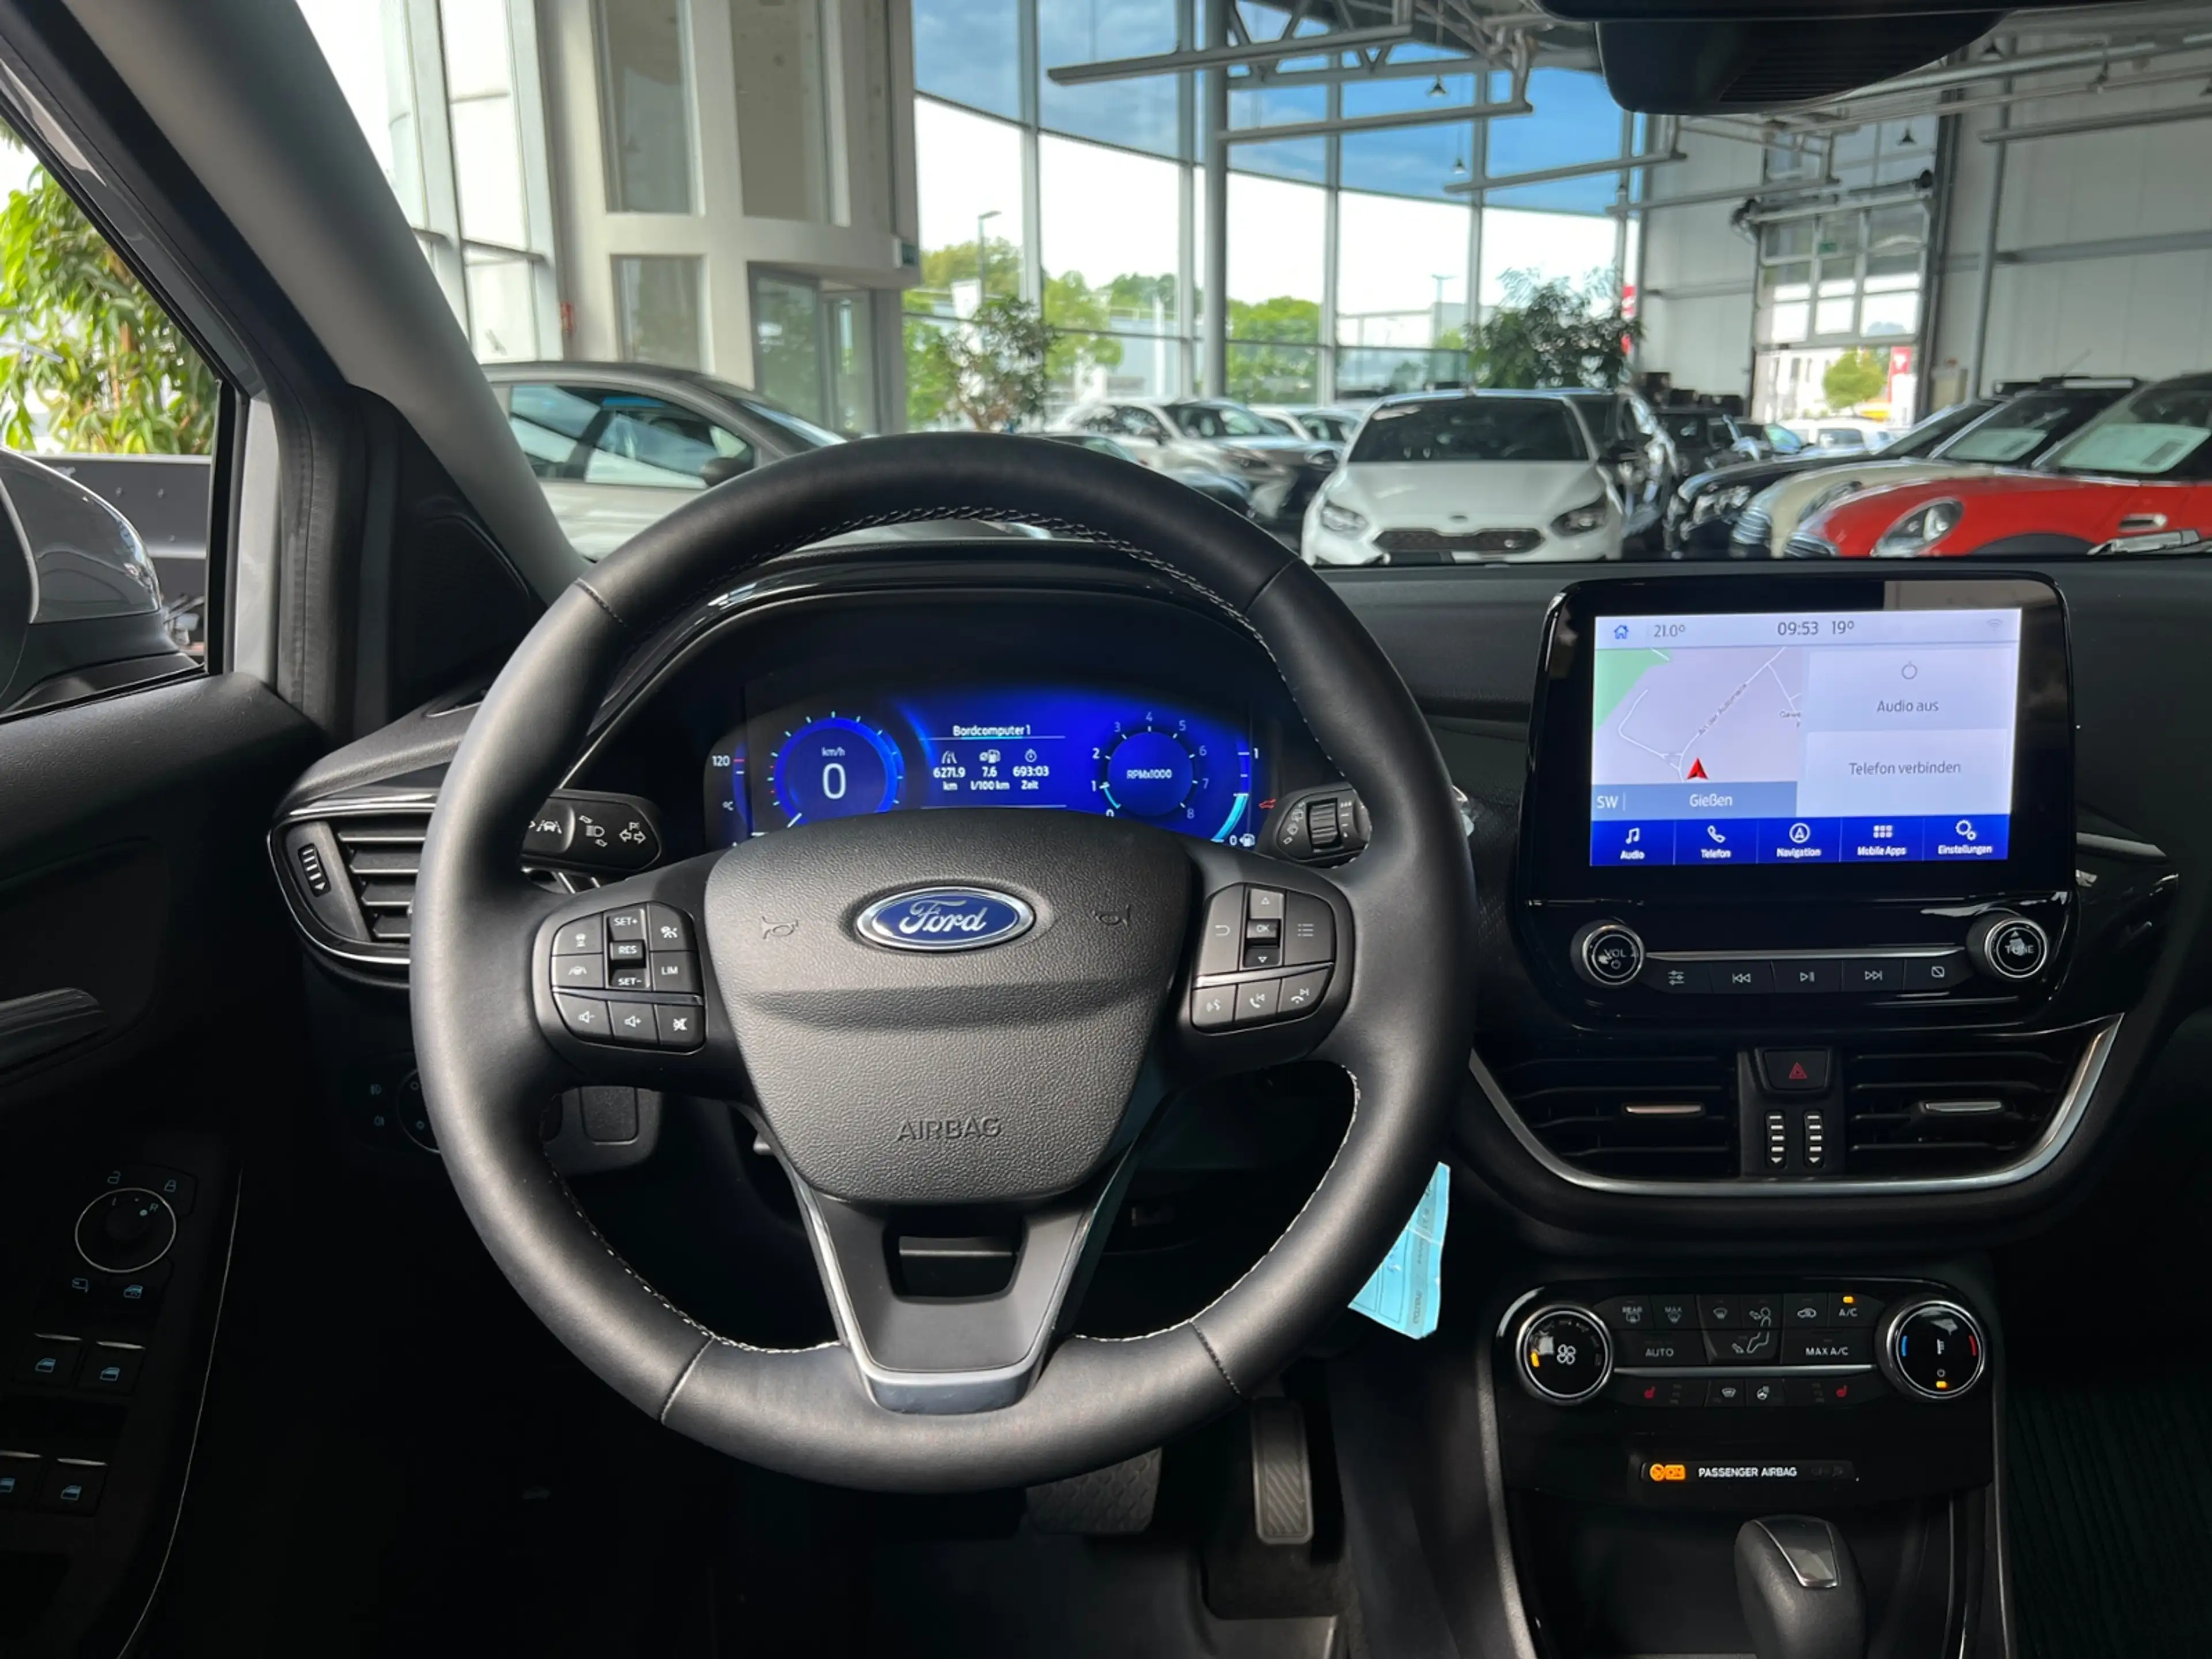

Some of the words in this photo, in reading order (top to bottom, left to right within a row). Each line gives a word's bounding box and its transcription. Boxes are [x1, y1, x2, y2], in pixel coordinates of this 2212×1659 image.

[1778, 622, 1819, 636] 09:53
[1877, 700, 1914, 713] Audio
[1916, 701, 1939, 711] aus
[1146, 712, 1153, 721] 4
[953, 725, 1024, 737] Bordcomputer
[1026, 724, 1031, 735] 1
[1114, 722, 1121, 733] 3
[1179, 721, 1186, 731] 5
[821, 747, 845, 756] km/h
[1092, 748, 1100, 759] 2
[1199, 745, 1207, 756] 6
[1253, 748, 1259, 759] 1
[712, 755, 730, 767] 120
[982, 766, 997, 777] 7.6
[1013, 766, 1050, 777] 693:03
[1849, 762, 1895, 775] Telefon
[1898, 760, 1961, 774] verbinden
[1127, 769, 1172, 779] RPMx1000
[823, 763, 846, 800] 0
[943, 781, 957, 790] km
[995, 781, 1010, 790] km
[1021, 779, 1039, 790] Zeit
[1091, 780, 1096, 791] 1
[1202, 778, 1209, 789] 7
[1597, 795, 1619, 809] SW
[1690, 793, 1733, 807] Gießen
[1187, 808, 1195, 819] 8
[1229, 835, 1237, 845] 0
[1620, 850, 1645, 860] Audio
[1701, 849, 1732, 858] Telefon
[1777, 847, 1821, 858] Navigation
[1857, 846, 1884, 855] Mobile
[1885, 846, 1907, 857] Apps
[1938, 845, 1993, 855] Einstellungen
[899, 900, 987, 934] Ford
[1256, 924, 1270, 933] OK
[619, 945, 637, 955] RES
[661, 966, 679, 975] LIM
[896, 1116, 1002, 1141] AIRBAG
[1838, 1308, 1858, 1317] A/C
[1645, 1348, 1674, 1357] AUTO
[1805, 1347, 1828, 1356] MAX
[1830, 1347, 1849, 1355] A/C
[1698, 1467, 1758, 1478] PASSENGER
[1760, 1467, 1797, 1477] AIRBAG
